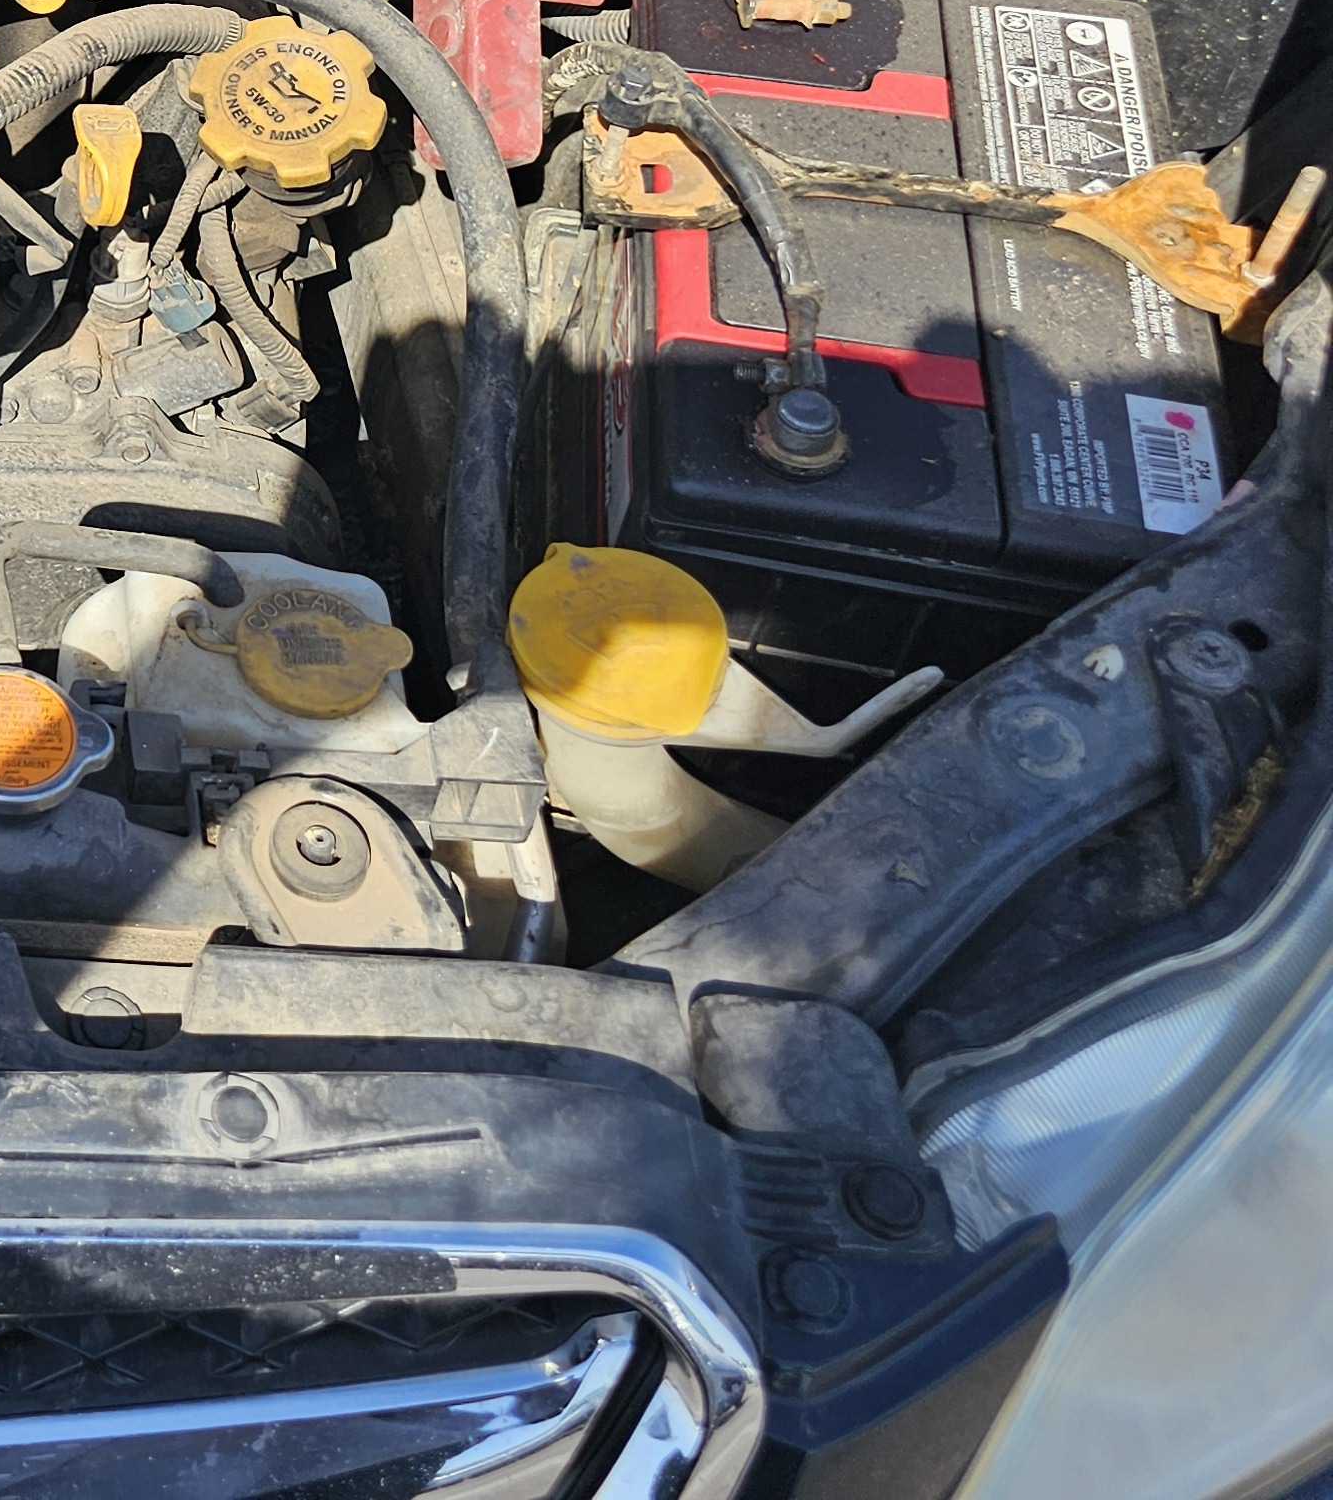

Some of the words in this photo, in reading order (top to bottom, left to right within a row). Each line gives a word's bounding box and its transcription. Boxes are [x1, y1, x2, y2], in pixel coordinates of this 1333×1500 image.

[236, 47, 268, 71] SEE
[276, 43, 340, 75] ENGINE
[333, 78, 346, 103] OIL
[225, 73, 265, 136] OWNER'S
[245, 87, 285, 123] 5W-30
[269, 113, 338, 141] MANUAL
[1117, 67, 1149, 176] DANGER/POISO
